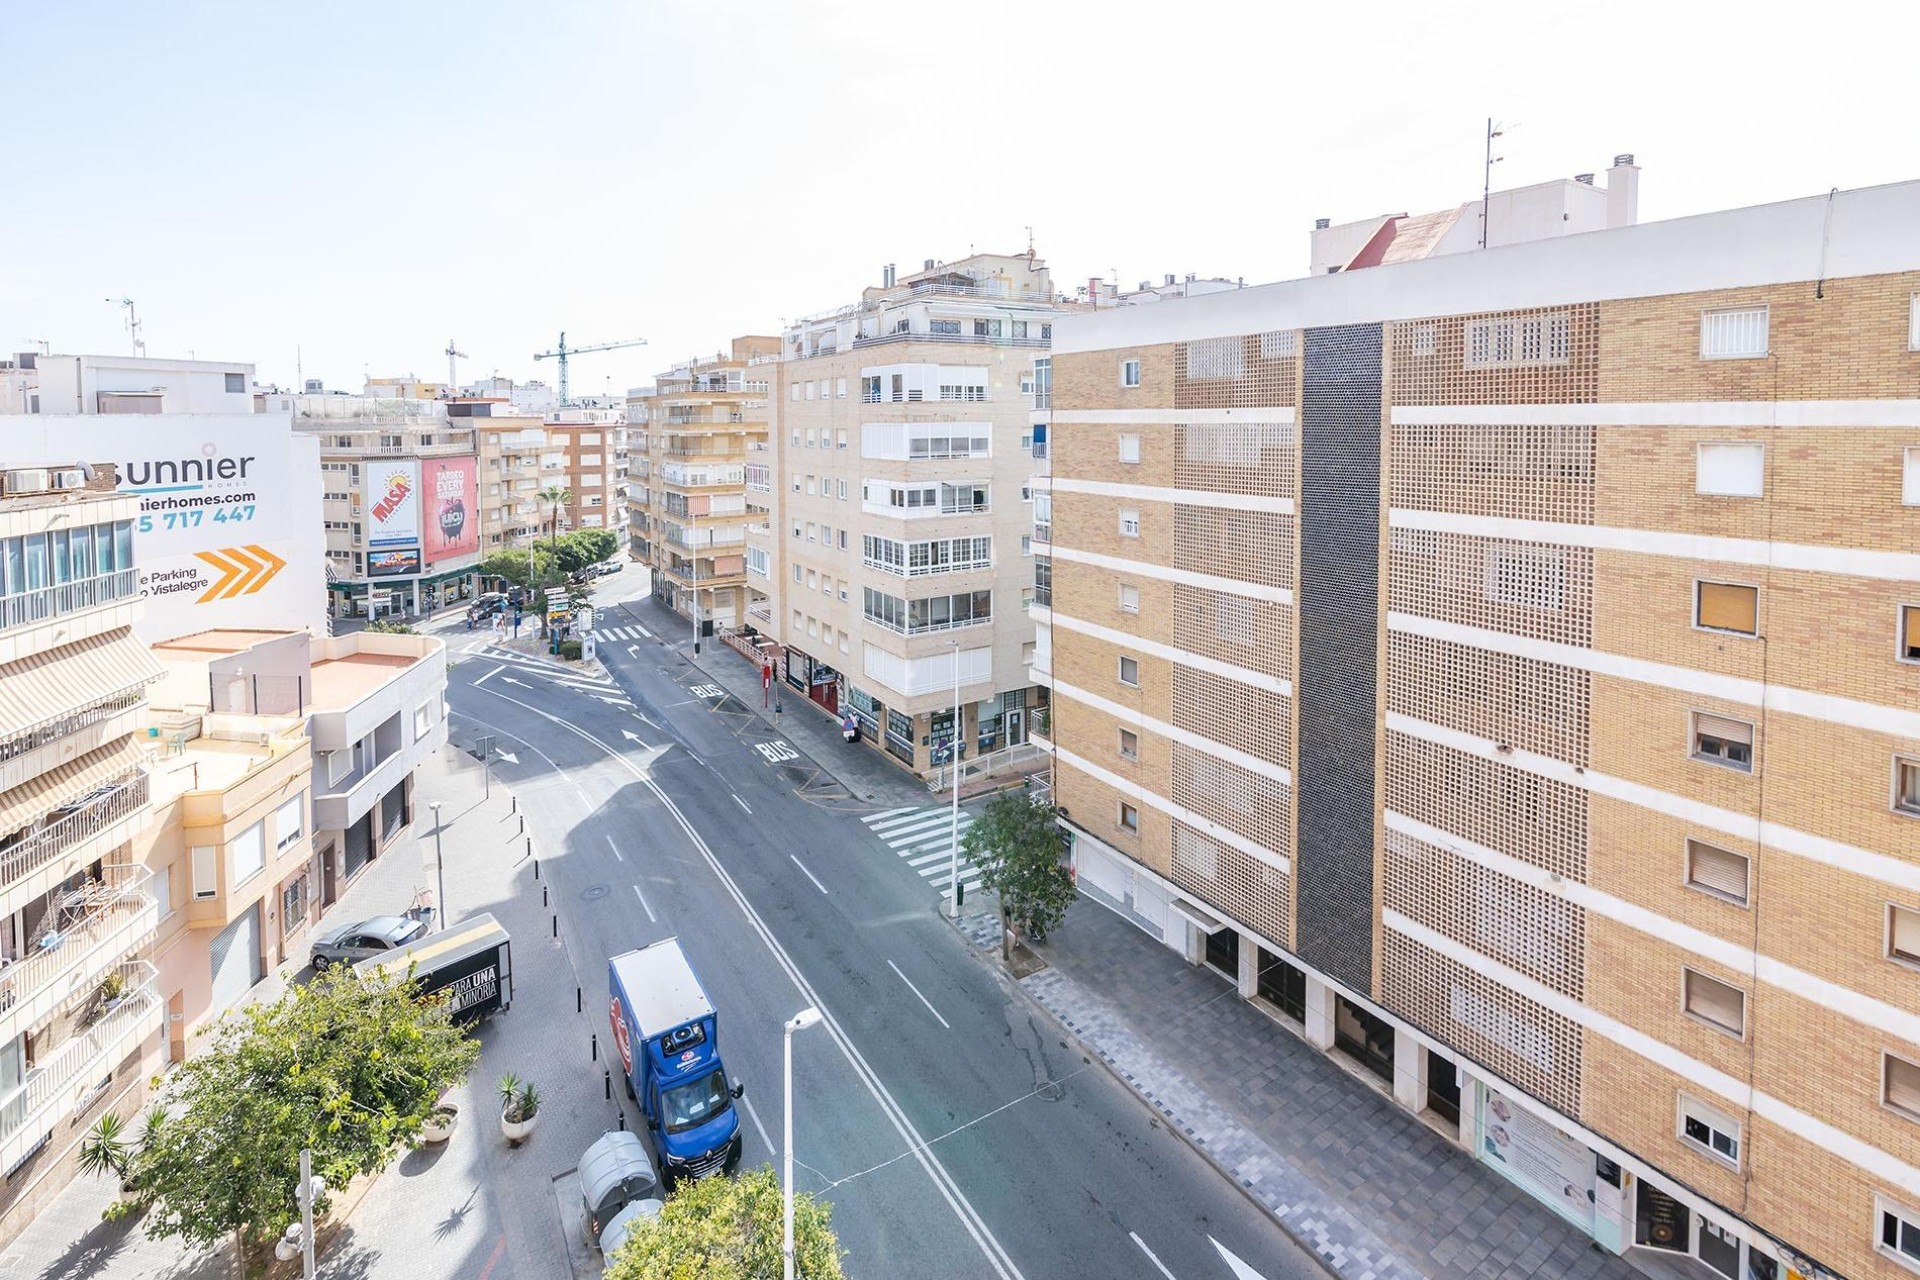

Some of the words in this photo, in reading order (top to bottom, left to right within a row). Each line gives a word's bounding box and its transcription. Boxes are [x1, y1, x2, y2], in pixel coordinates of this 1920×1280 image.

[371, 482, 411, 524] MASA
[163, 510, 204, 530] 717
[213, 505, 256, 524] 447
[151, 568, 197, 583] Parking
[151, 579, 209, 596] Vistalegre
[689, 684, 725, 699] BUS
[755, 740, 800, 763] BUS
[472, 967, 496, 987] UNA
